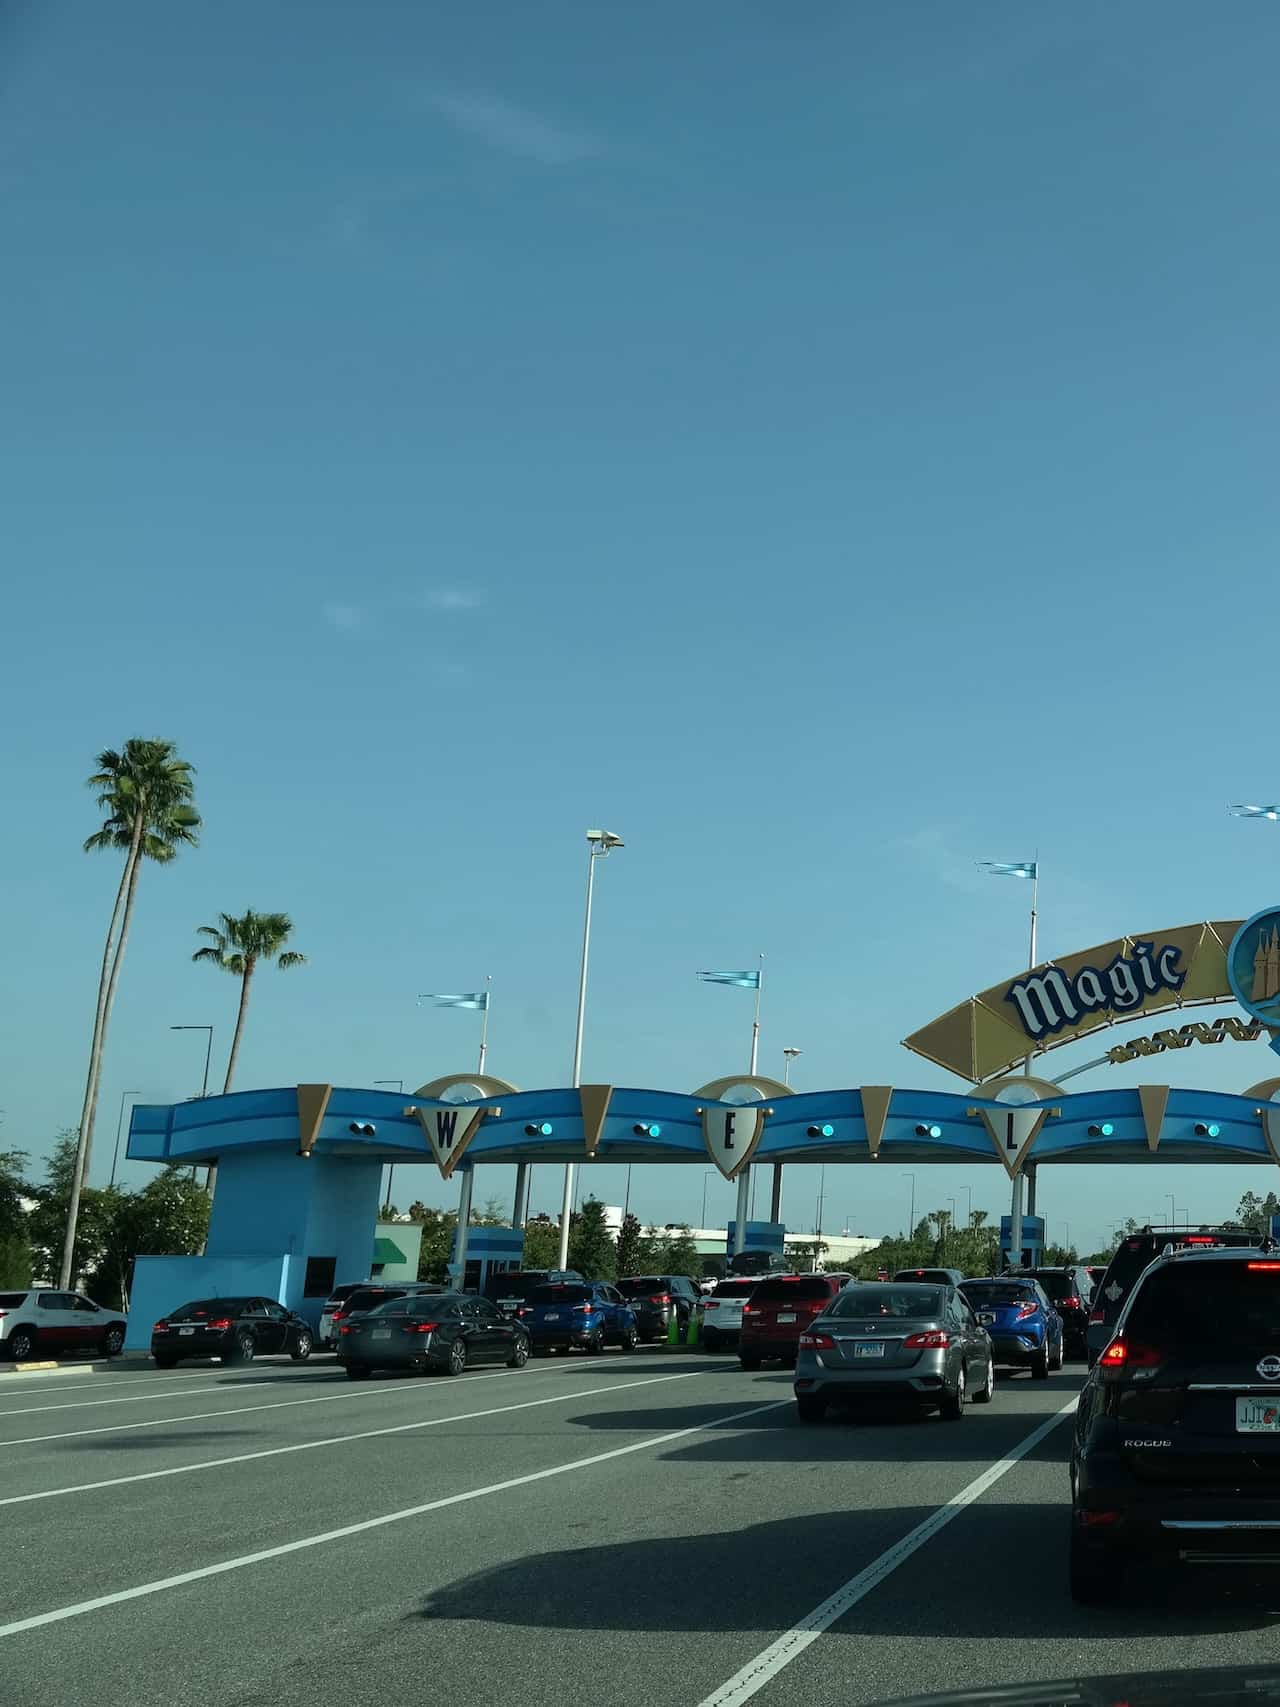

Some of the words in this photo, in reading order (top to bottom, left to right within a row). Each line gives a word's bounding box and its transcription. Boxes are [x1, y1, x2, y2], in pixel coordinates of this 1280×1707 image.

[1008, 943, 1184, 1037] Magic
[436, 1112, 458, 1149] W
[724, 1112, 737, 1149] E
[1006, 1113, 1018, 1149] L
